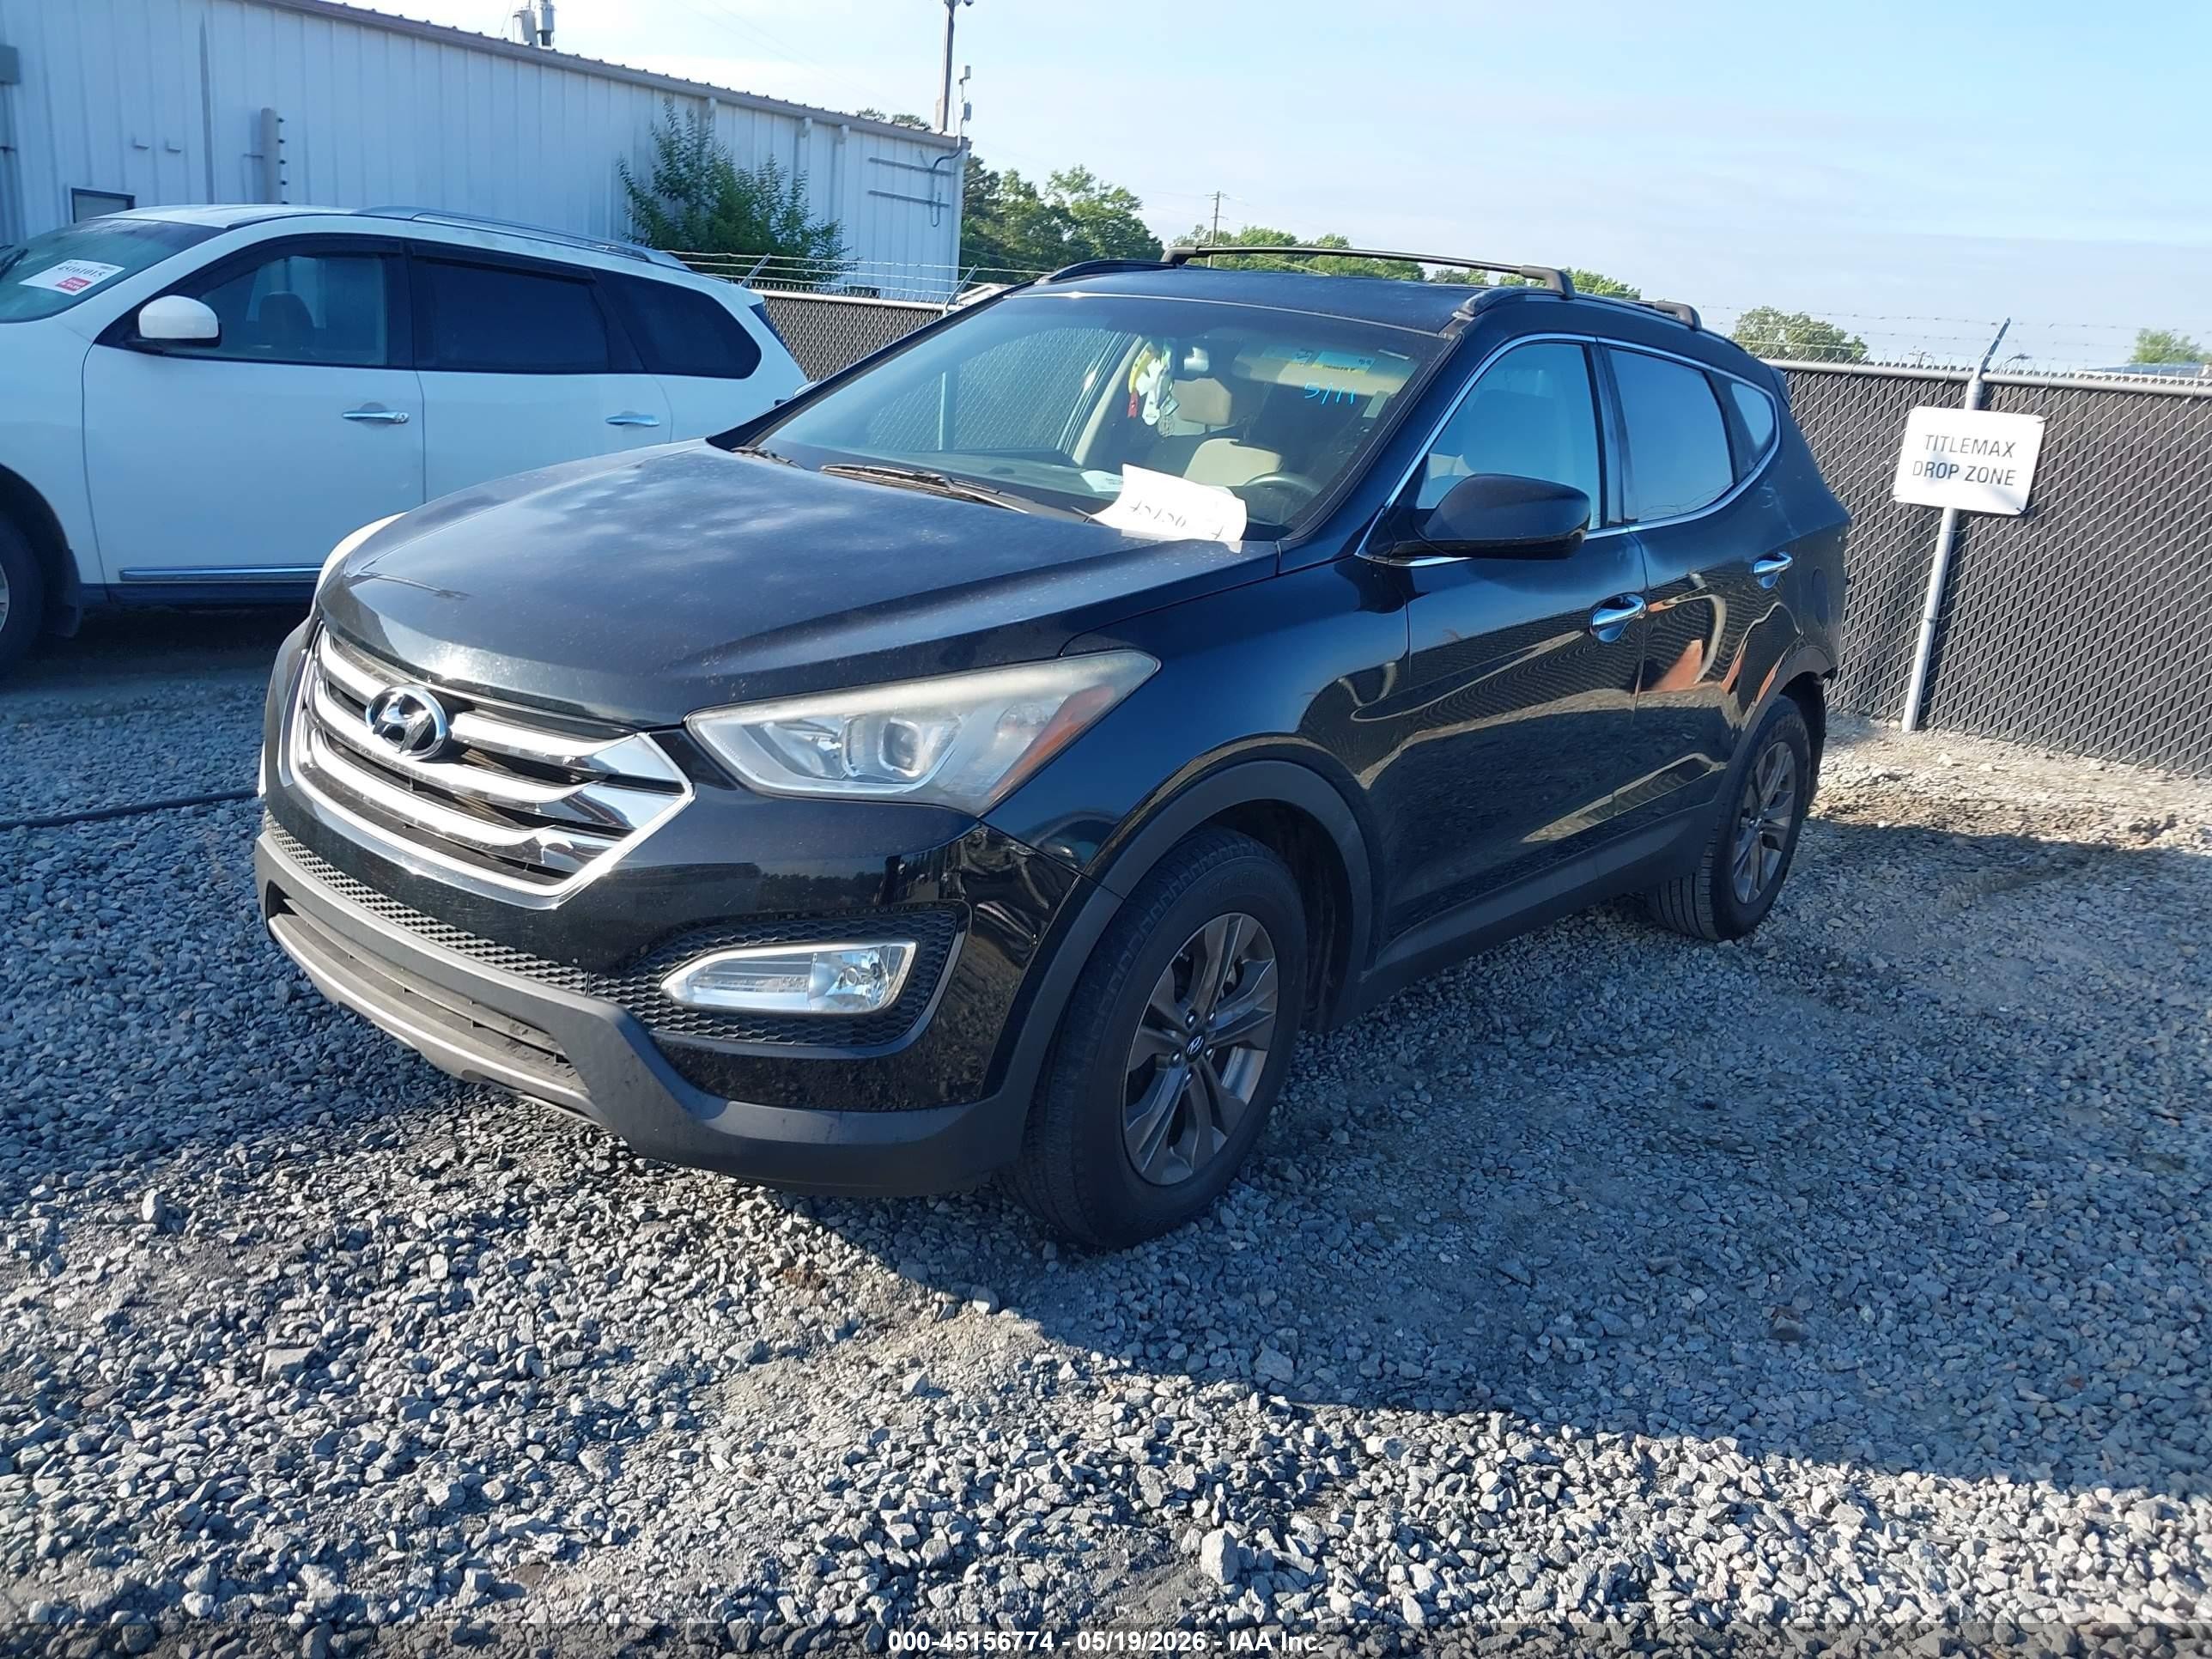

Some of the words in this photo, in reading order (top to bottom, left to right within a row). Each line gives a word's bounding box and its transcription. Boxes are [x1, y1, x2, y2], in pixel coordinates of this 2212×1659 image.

[1925, 434, 2015, 458] TITLEMAX
[1912, 460, 1960, 479] DROP
[1965, 465, 2016, 485] ZONE
